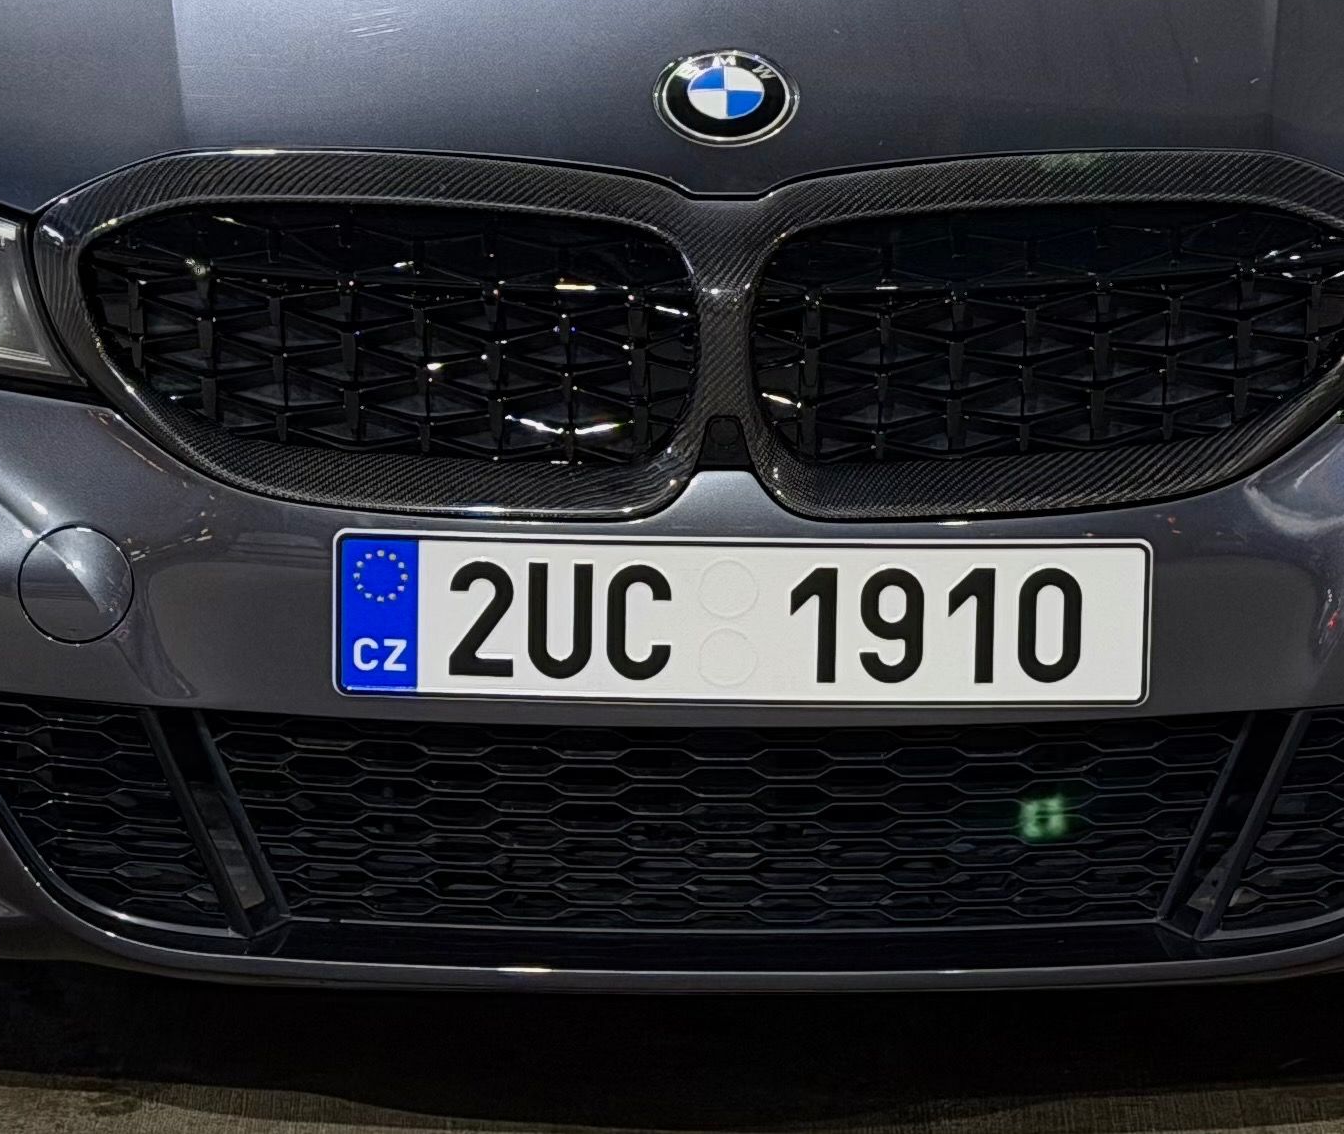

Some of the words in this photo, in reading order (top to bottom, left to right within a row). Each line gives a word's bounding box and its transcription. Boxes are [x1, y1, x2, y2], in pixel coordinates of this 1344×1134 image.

[676, 54, 777, 80] BMW
[449, 562, 671, 680] 2UC
[791, 568, 1082, 683] 1910
[354, 638, 406, 670] CZ
